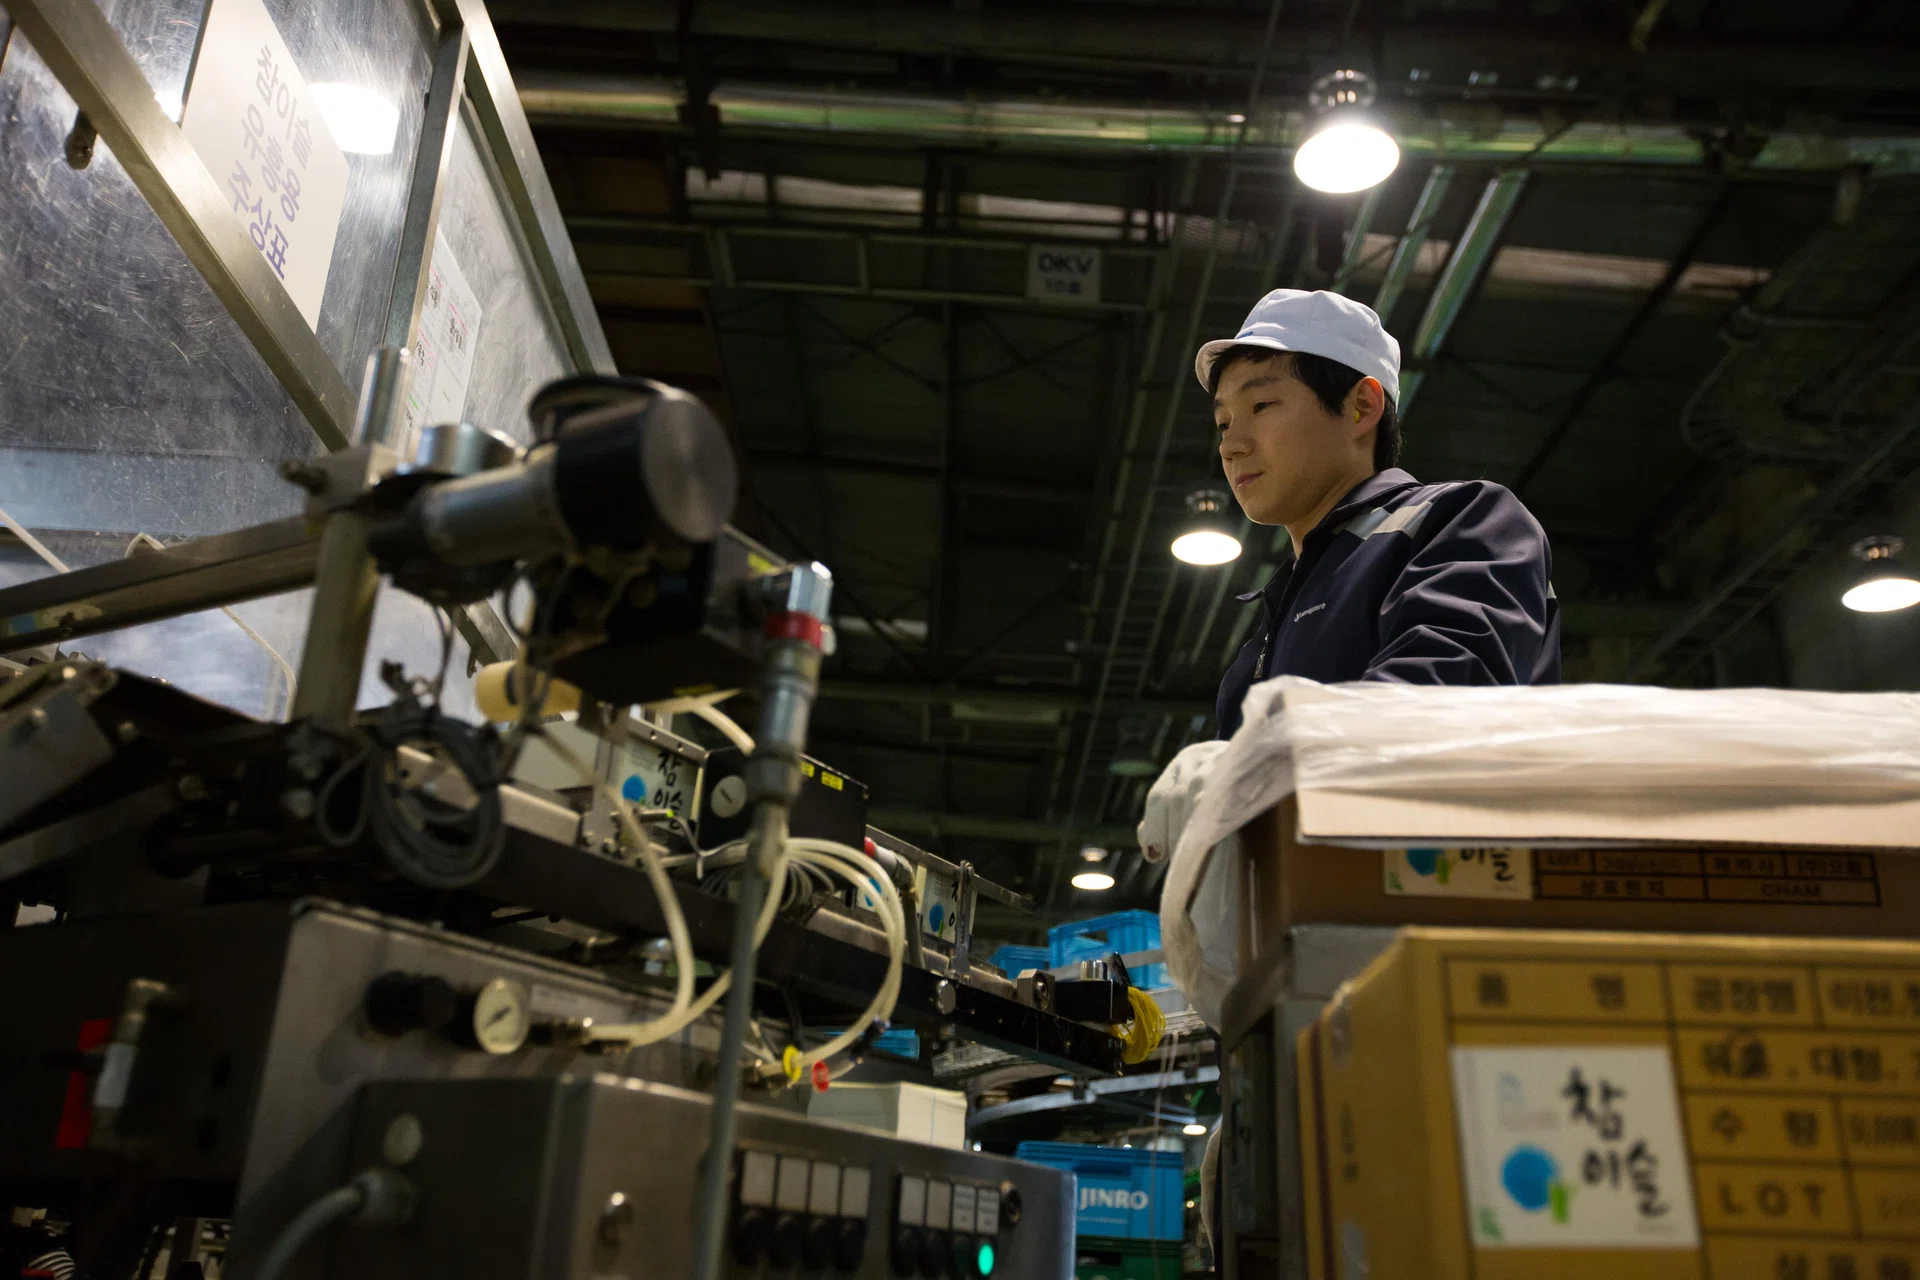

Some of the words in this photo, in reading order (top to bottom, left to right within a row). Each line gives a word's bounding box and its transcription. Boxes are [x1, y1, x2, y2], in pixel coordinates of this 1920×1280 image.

[256, 43, 313, 171] 참이슬
[241, 103, 302, 223] 유흥용
[227, 160, 290, 281] 주상표
[1761, 882, 1822, 898] CHAM
[1079, 1186, 1149, 1211] JINRO
[1582, 1138, 1669, 1217] 이슬
[1718, 1181, 1824, 1218] LOT
